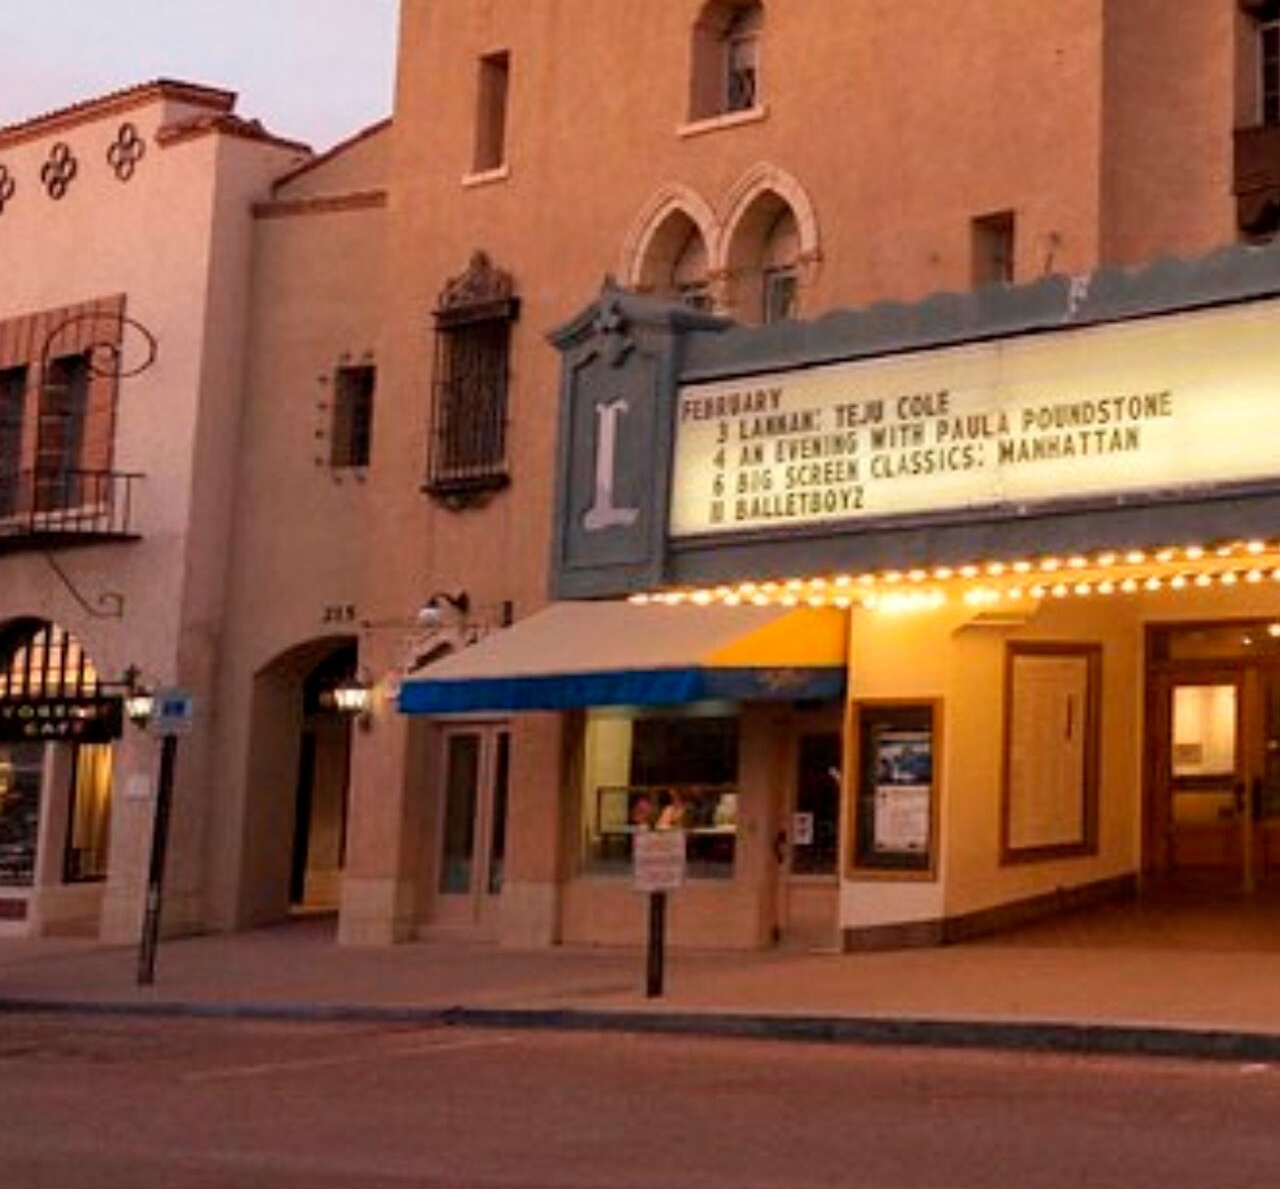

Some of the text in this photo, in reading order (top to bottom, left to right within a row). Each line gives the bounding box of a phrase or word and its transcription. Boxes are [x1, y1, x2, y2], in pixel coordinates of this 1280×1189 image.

[681, 389, 783, 420] FEBRUARY
[713, 391, 1173, 469] 4 AN EVENING WITH PAULA POUNDSTONE
[717, 421, 728, 443] 3
[834, 400, 884, 427] TEJU
[897, 391, 951, 419] COLE
[737, 469, 772, 494] BIG
[785, 462, 859, 489] SCREEN
[870, 444, 984, 478] CLASSICS:
[999, 426, 1140, 465] MANHATTAN
